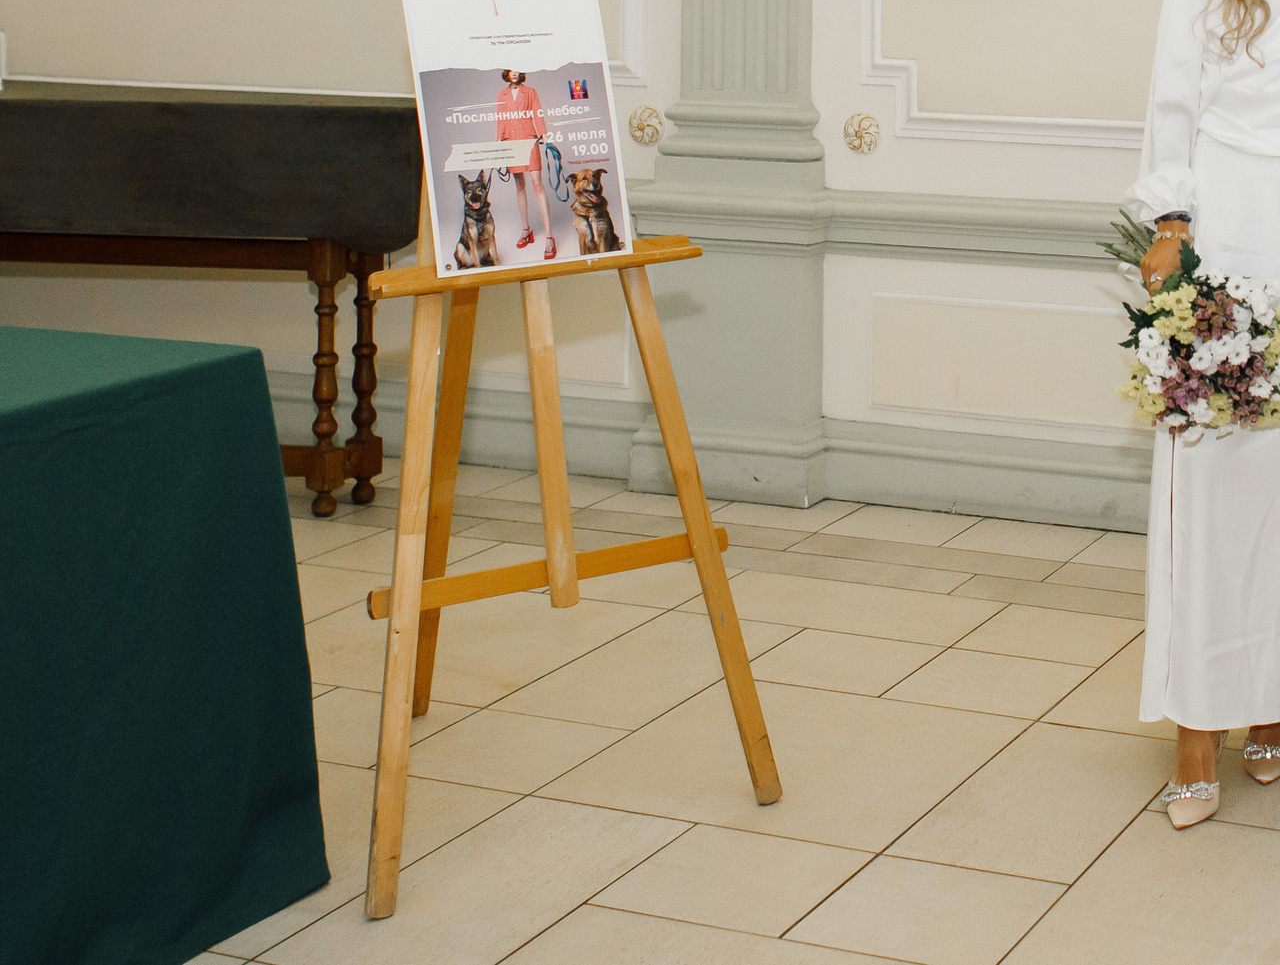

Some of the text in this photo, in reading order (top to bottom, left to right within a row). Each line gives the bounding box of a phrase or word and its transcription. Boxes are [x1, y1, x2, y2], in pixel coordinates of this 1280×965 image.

[445, 104, 591, 124] «Посланники с небес»
[547, 129, 607, 143] 26 июля
[571, 142, 609, 157] 19.00
